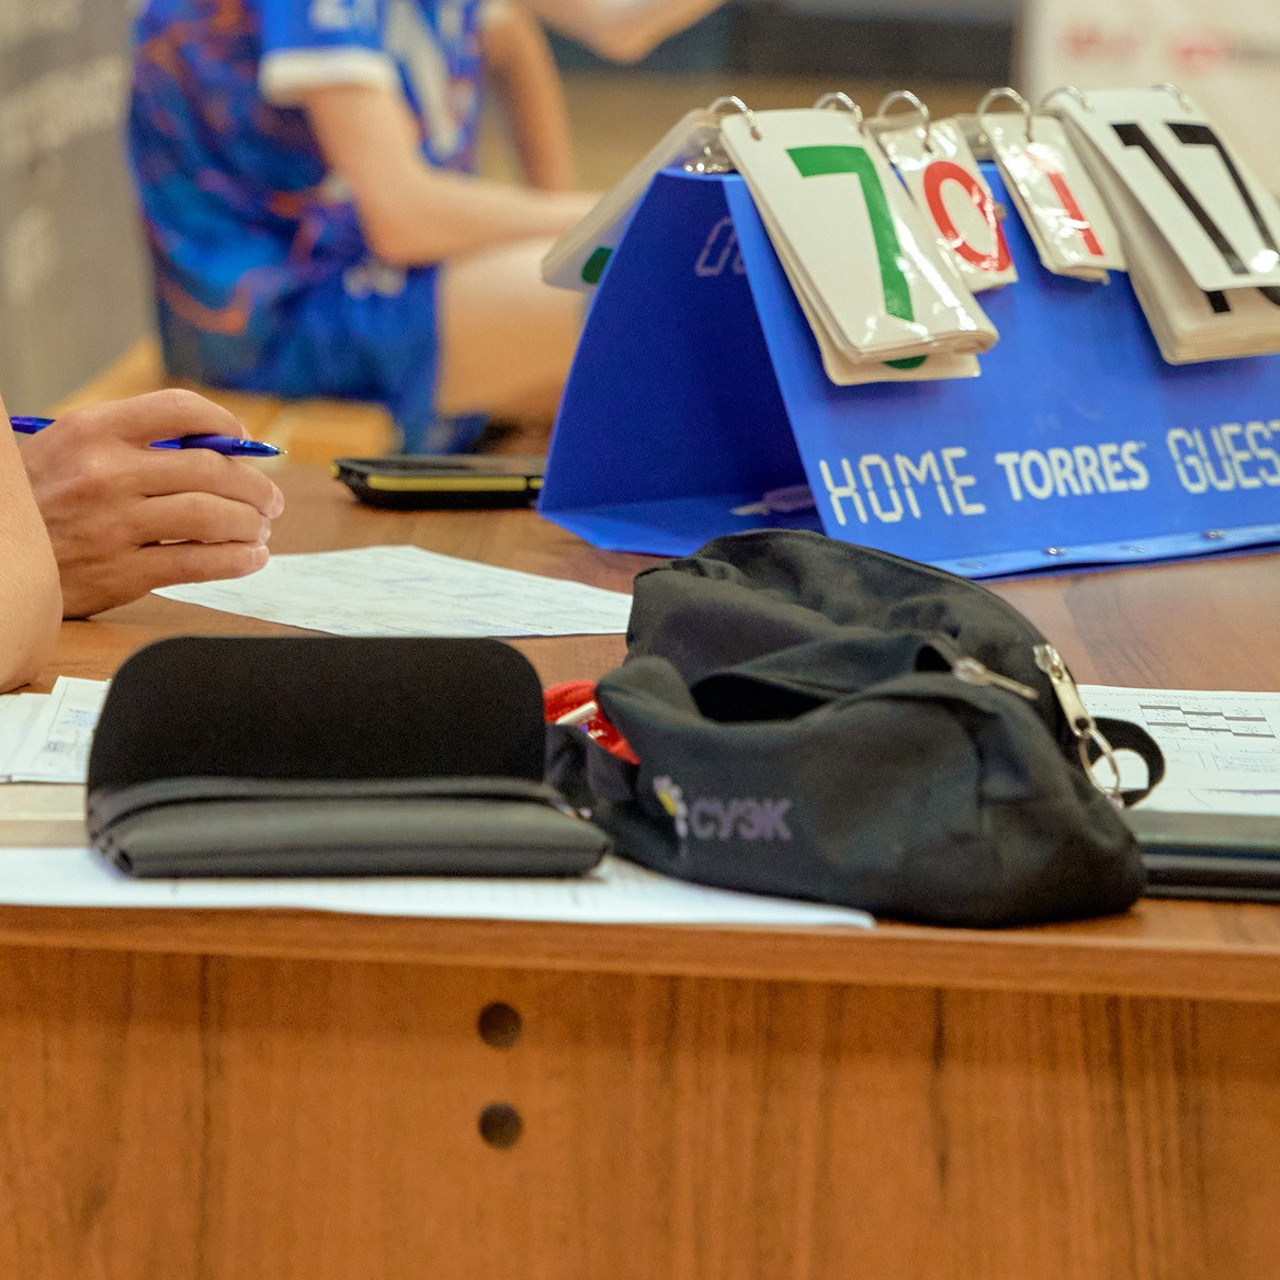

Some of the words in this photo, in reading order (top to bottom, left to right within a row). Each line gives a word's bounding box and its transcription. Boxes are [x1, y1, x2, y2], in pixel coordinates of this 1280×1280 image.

[785, 144, 916, 323] 7
[923, 160, 1012, 273] 0
[1024, 150, 1105, 256] 1
[1110, 122, 1280, 275] 17
[820, 446, 987, 526] HOME
[995, 440, 1150, 502] TORRES
